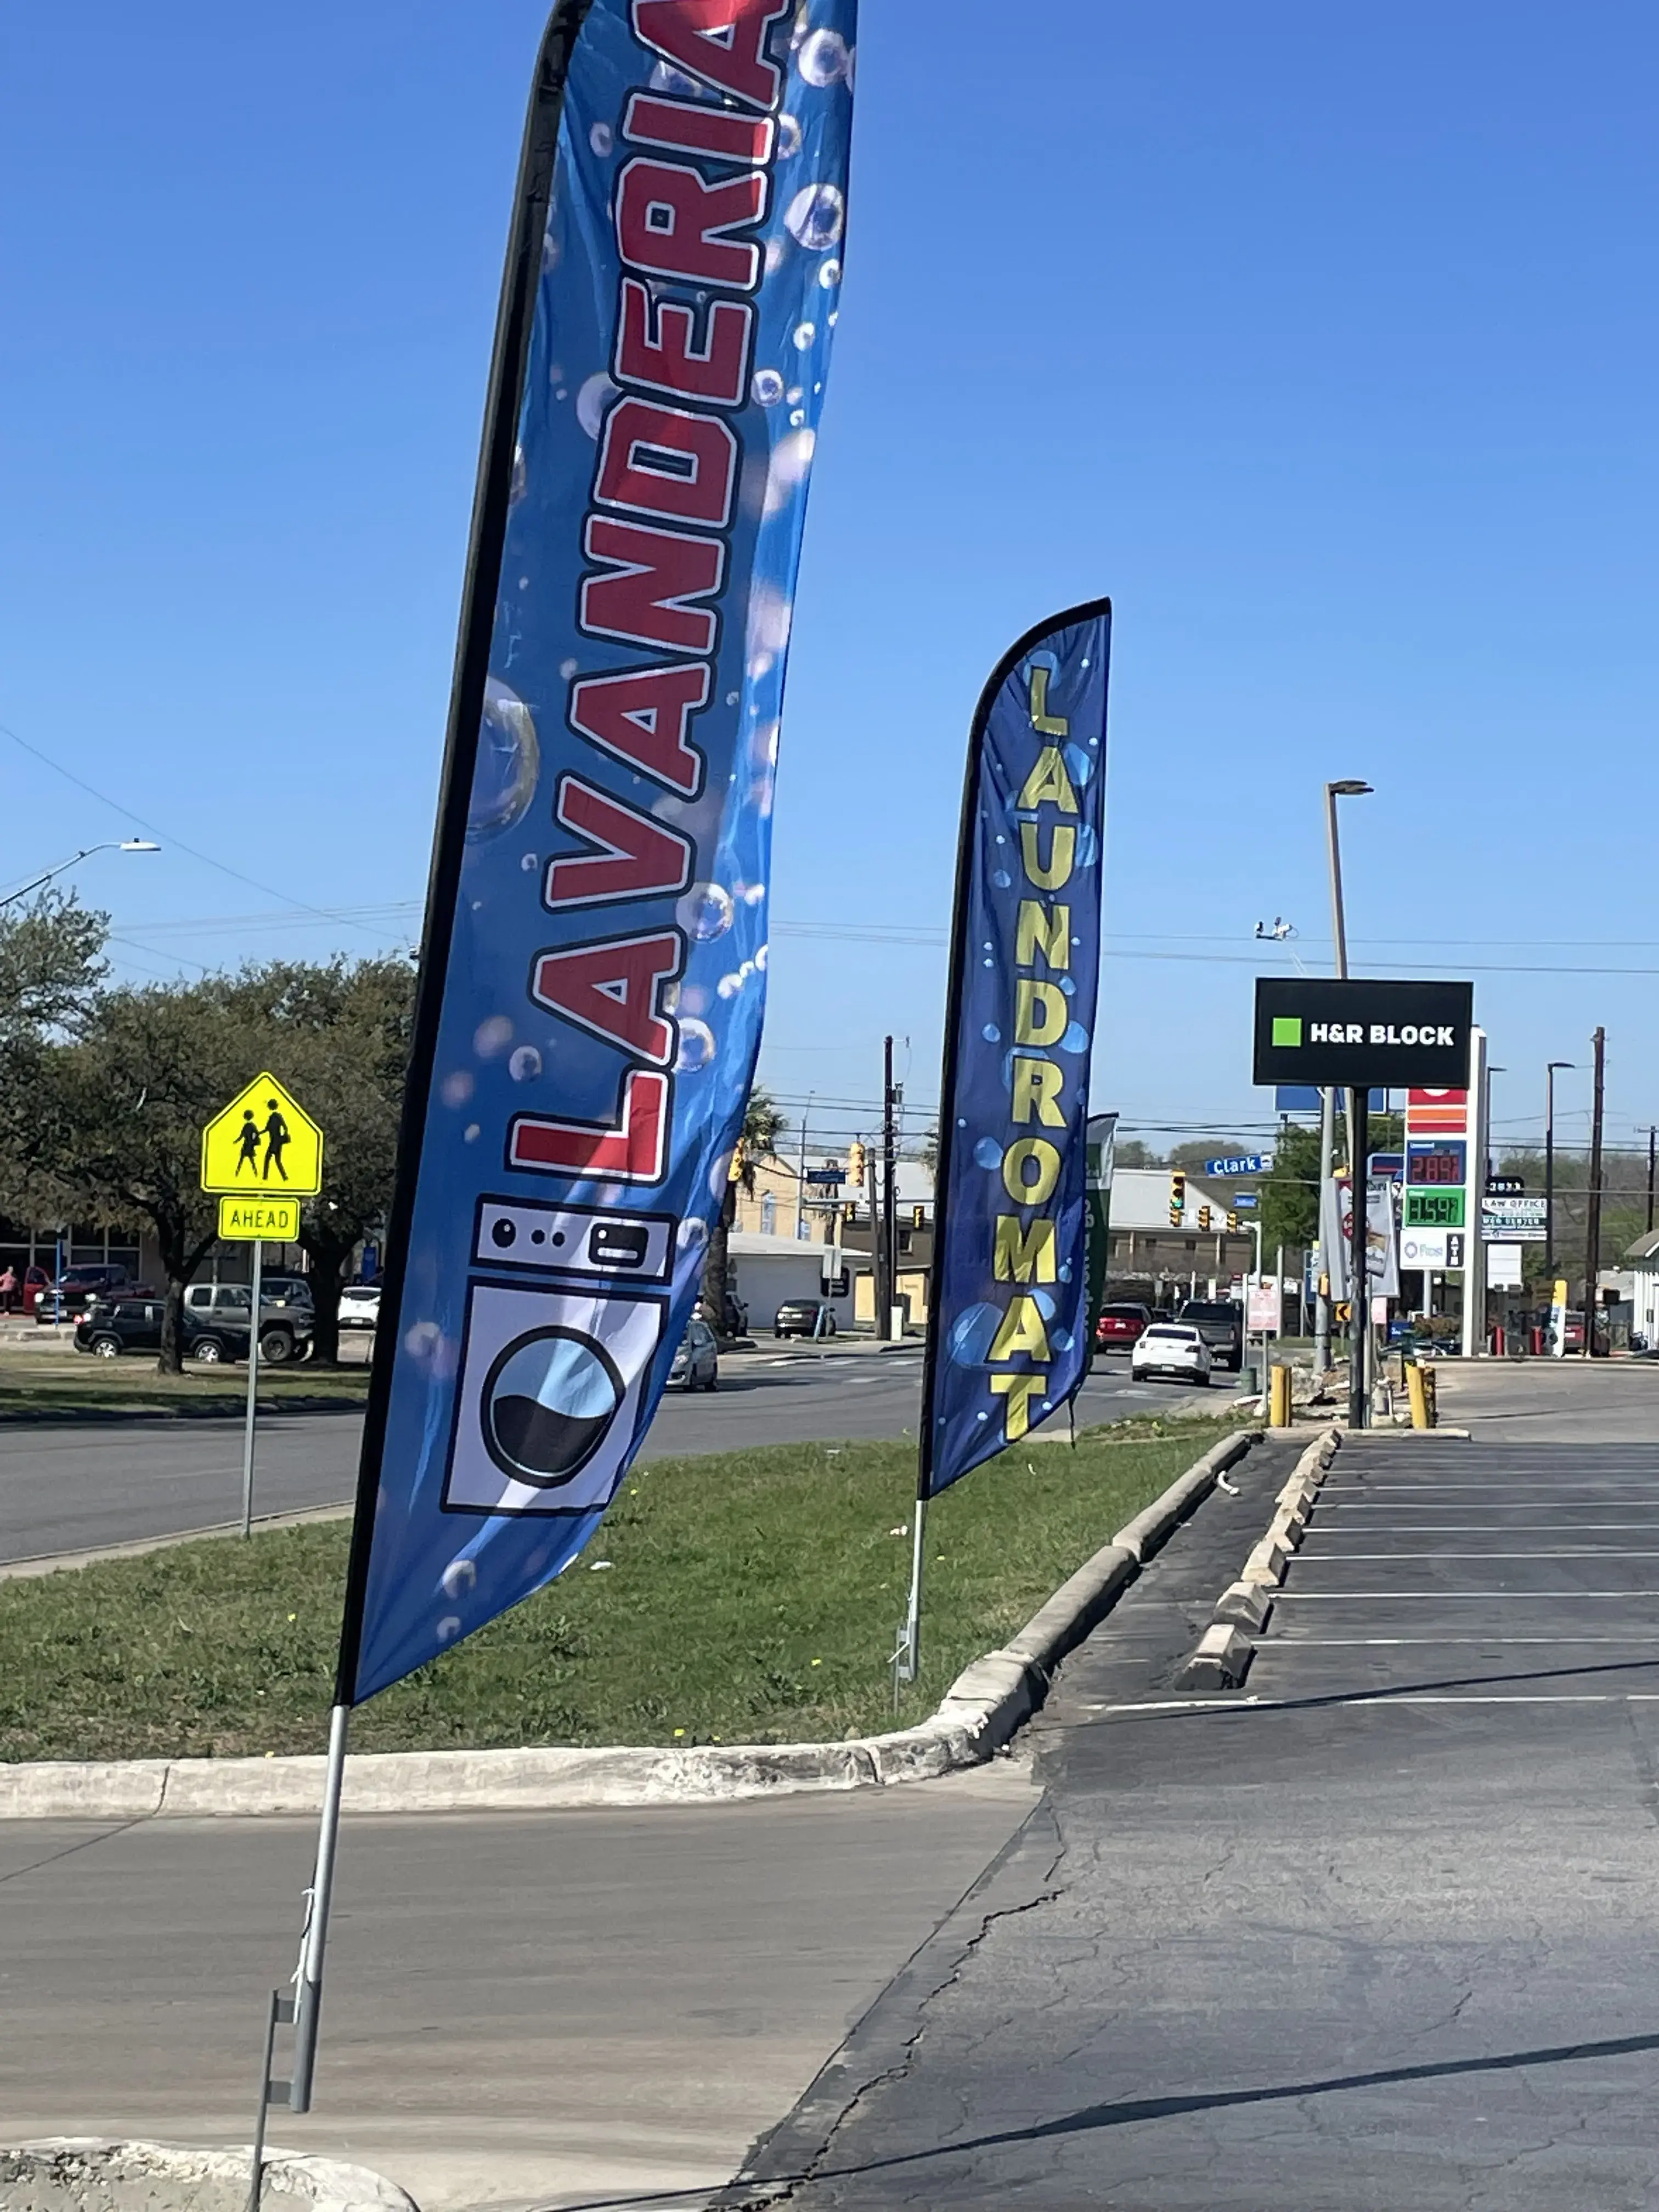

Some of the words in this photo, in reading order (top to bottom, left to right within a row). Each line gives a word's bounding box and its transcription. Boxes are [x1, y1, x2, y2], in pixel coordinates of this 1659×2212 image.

[508, 0, 790, 1183] LAVANDERIA
[1310, 1023, 1364, 1043] H&R
[1370, 1024, 1454, 1046] BLOCK
[986, 666, 1080, 1441] LAUNDROMAT
[1214, 1155, 1256, 1174] Clark
[230, 1209, 289, 1228] AHEAD
